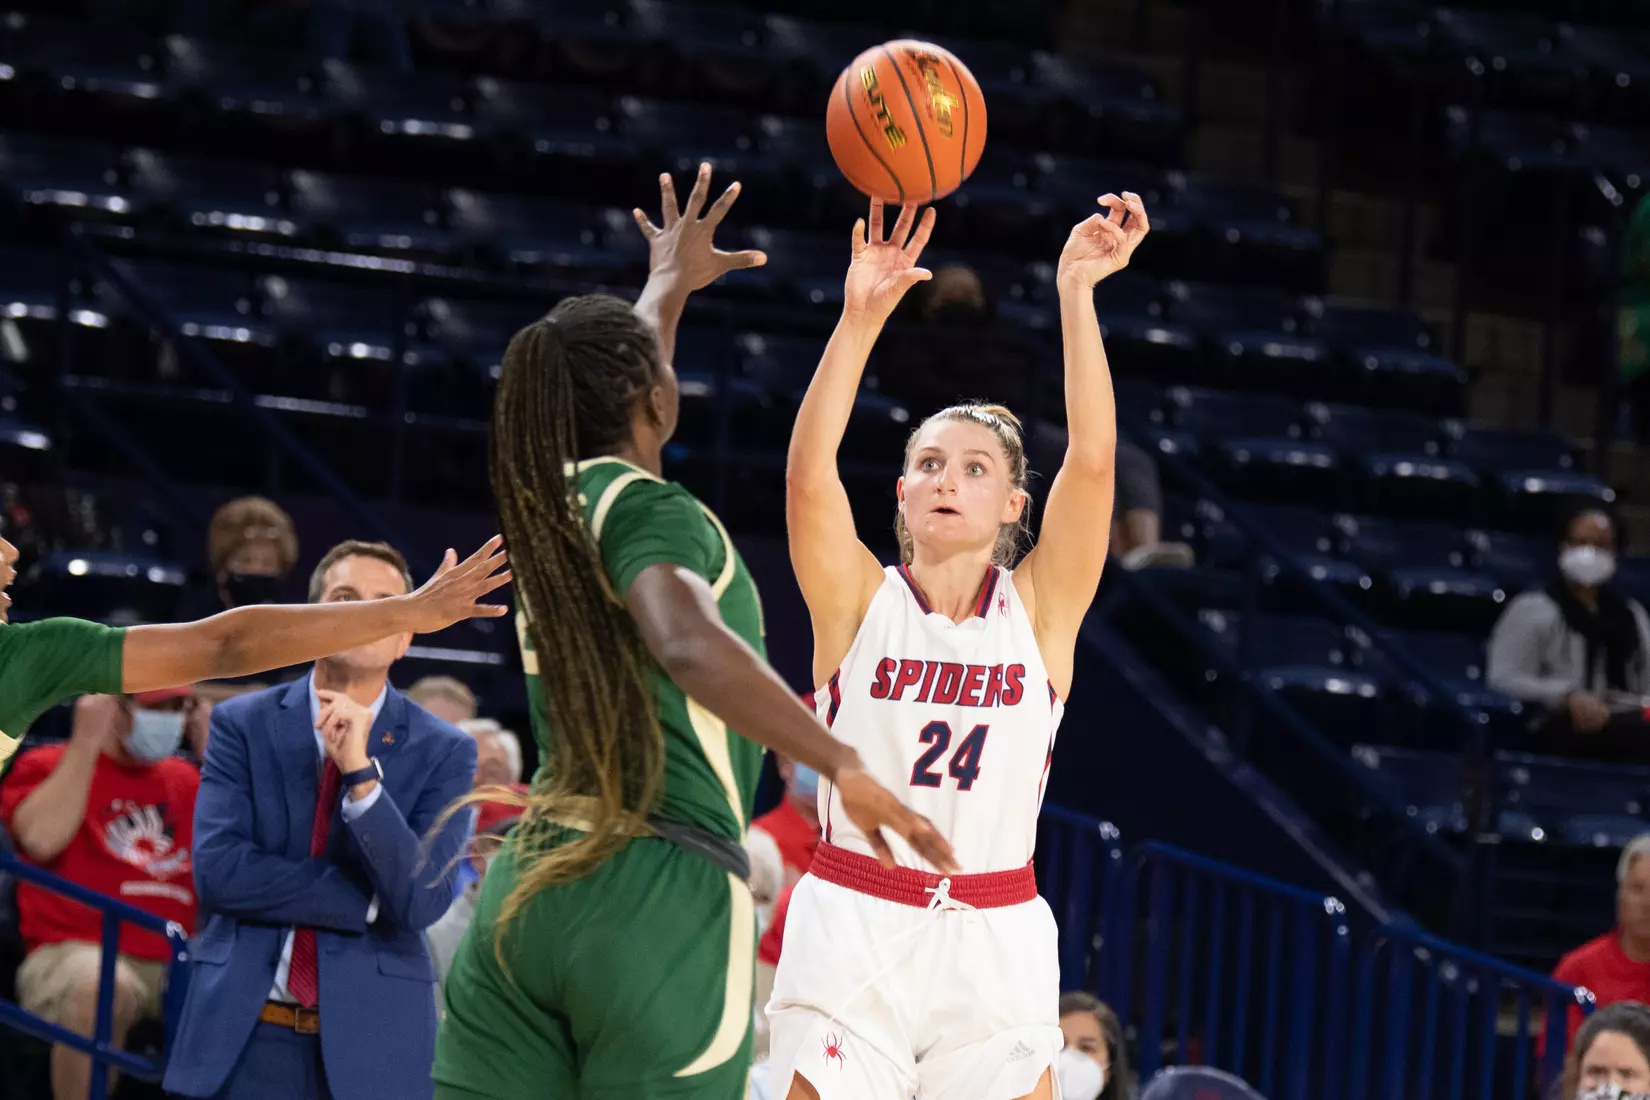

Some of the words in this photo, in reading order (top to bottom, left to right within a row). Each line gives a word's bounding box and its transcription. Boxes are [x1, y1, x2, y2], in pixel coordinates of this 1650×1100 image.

[861, 66, 906, 149] ELITE
[870, 657, 1026, 708] SPIDERS
[909, 720, 990, 791] 24
